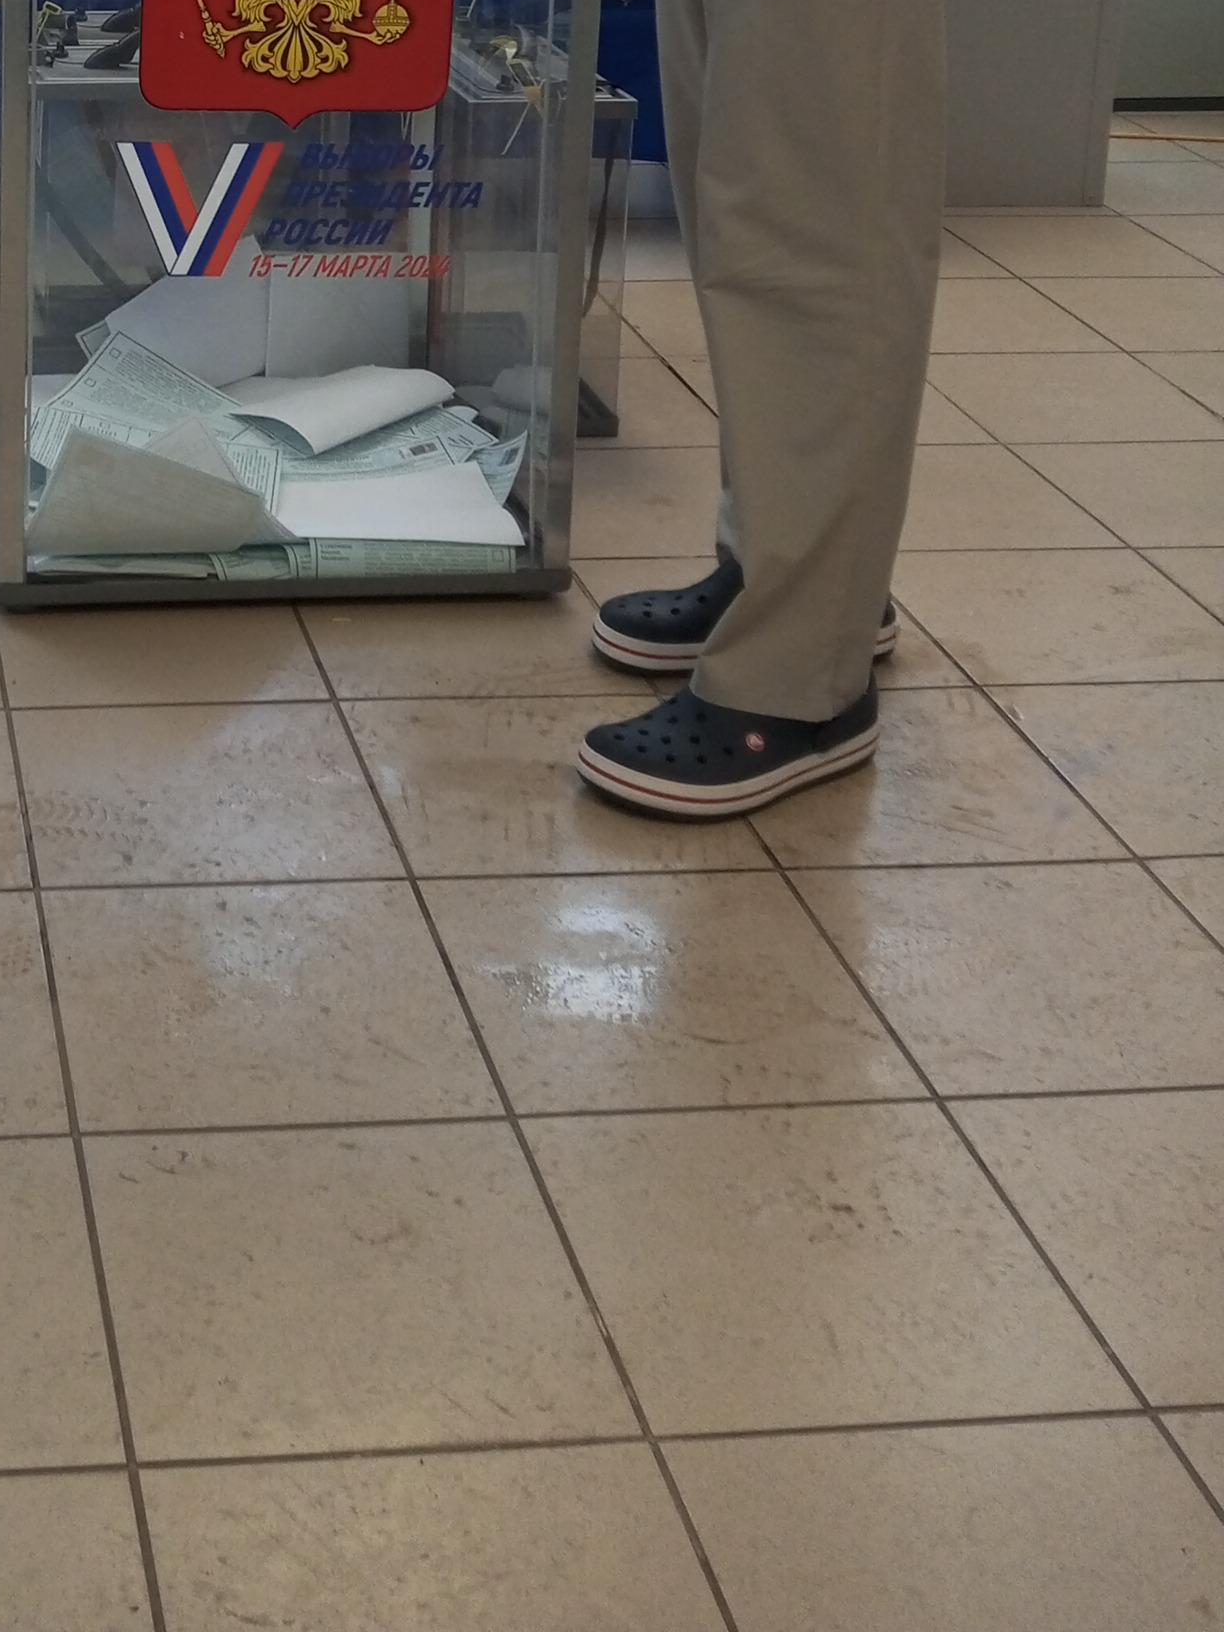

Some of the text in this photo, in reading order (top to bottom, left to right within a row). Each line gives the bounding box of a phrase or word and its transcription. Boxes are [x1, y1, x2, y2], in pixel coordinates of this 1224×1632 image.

[261, 219, 394, 246] РОССИИ
[313, 255, 392, 278] МАРТА
[394, 255, 452, 279] 2024
